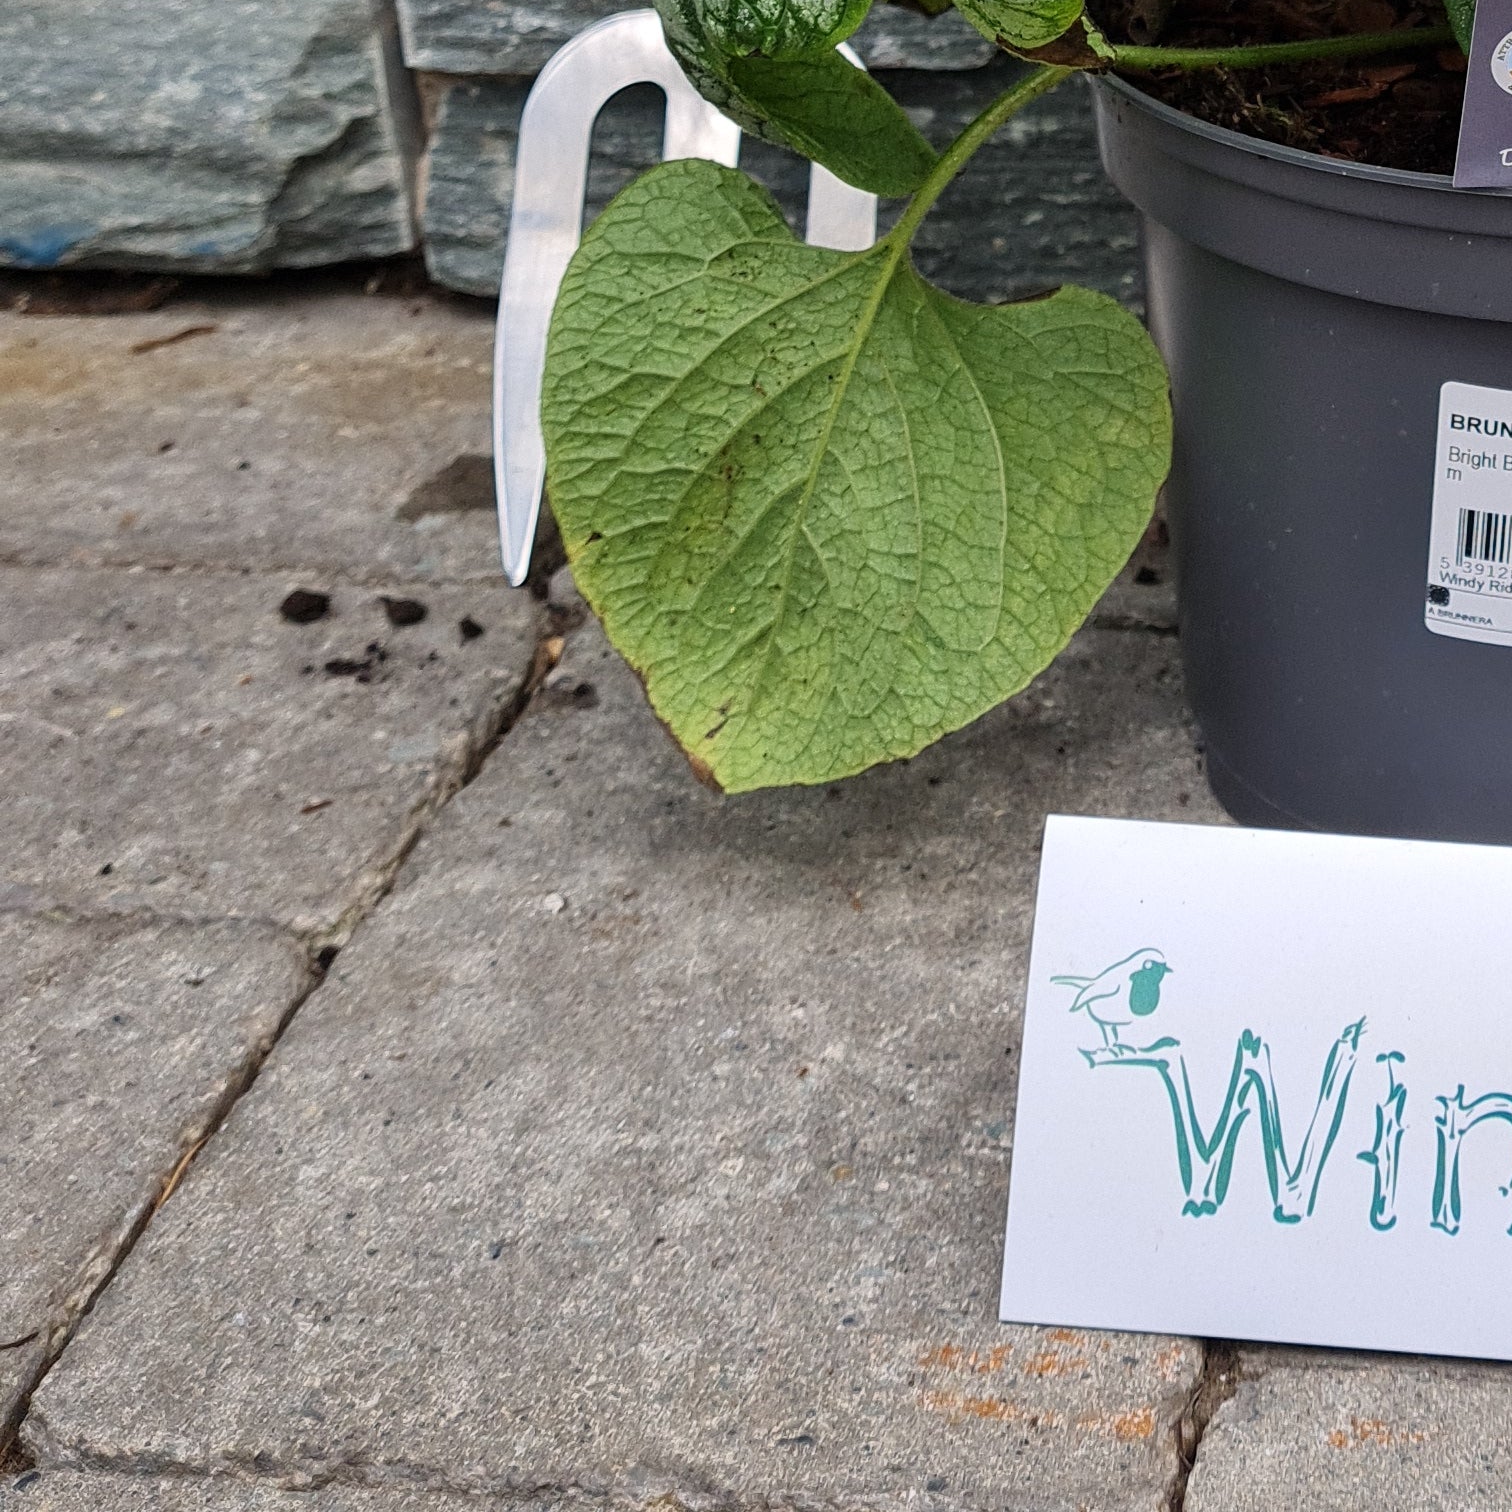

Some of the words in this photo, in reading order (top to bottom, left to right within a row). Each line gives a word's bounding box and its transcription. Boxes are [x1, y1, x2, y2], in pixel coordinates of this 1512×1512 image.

[1448, 446, 1497, 470] Bright
[1446, 467, 1462, 481] m
[1440, 556, 1450, 570] 5
[1439, 570, 1485, 592] Windy
